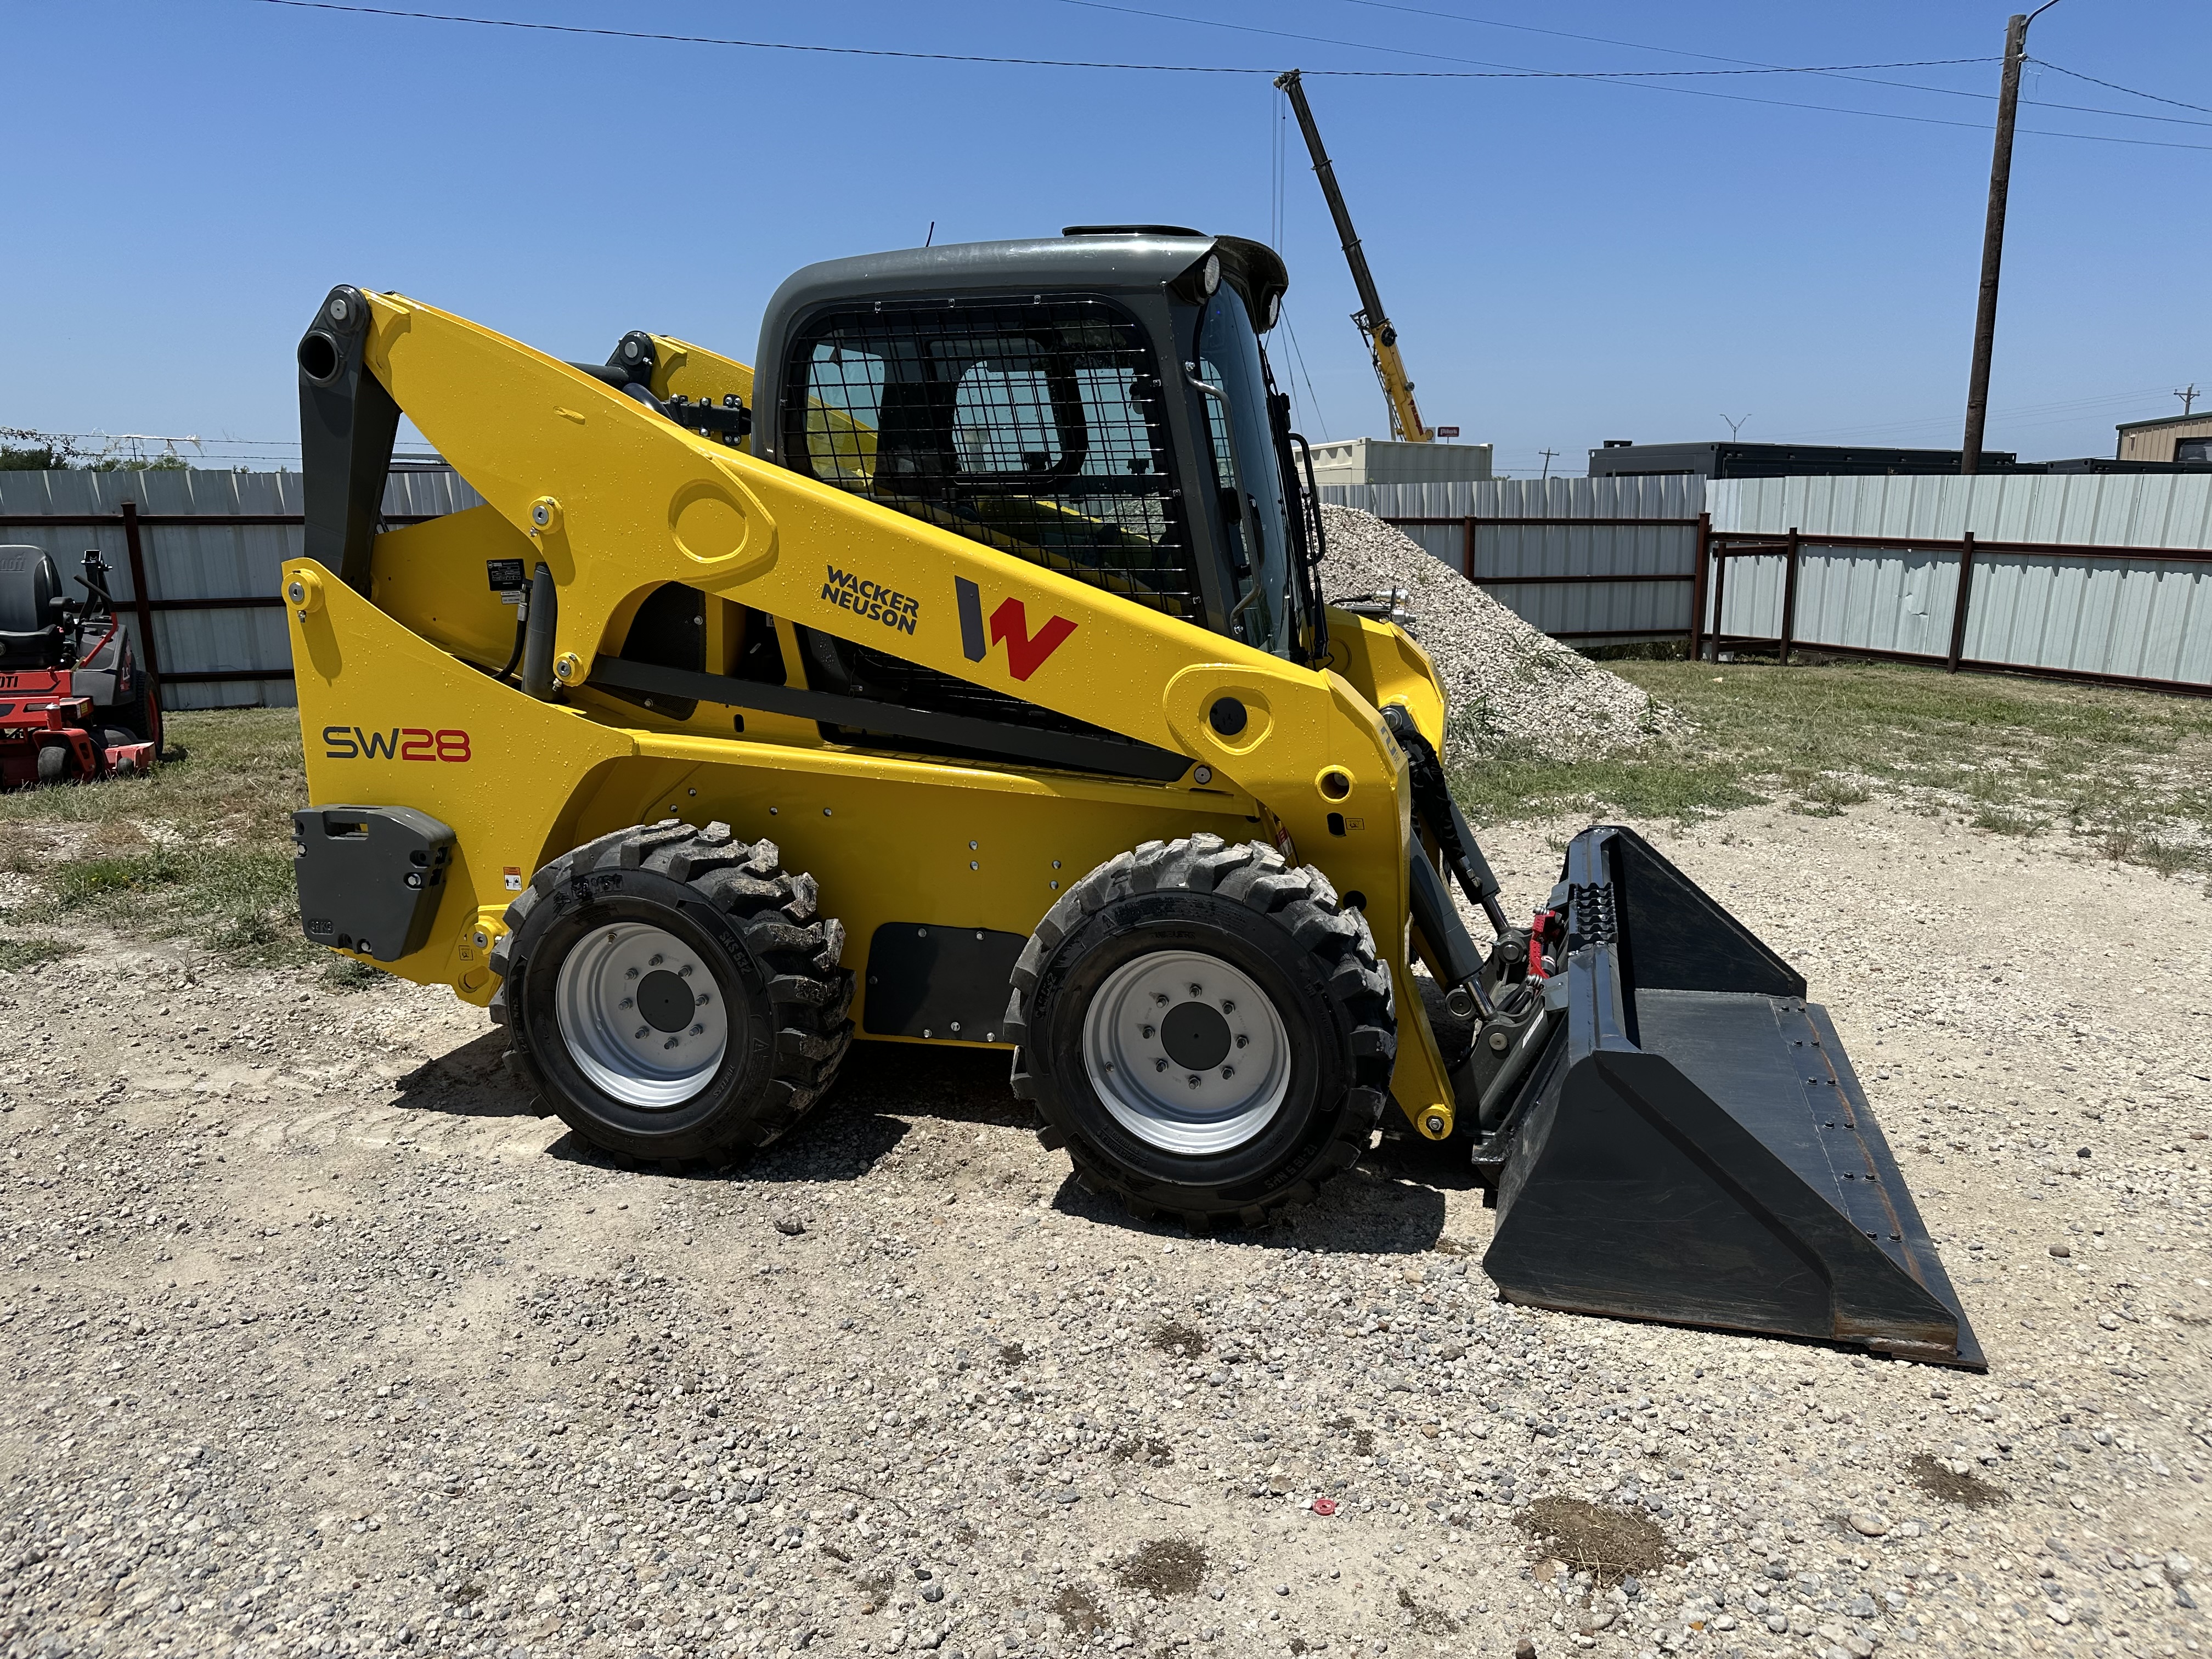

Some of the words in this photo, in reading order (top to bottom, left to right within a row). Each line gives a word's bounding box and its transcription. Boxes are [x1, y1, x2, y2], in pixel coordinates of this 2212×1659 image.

[821, 583, 917, 635] NEUSON
[827, 565, 919, 618] WACKER
[323, 726, 471, 762] SW28
